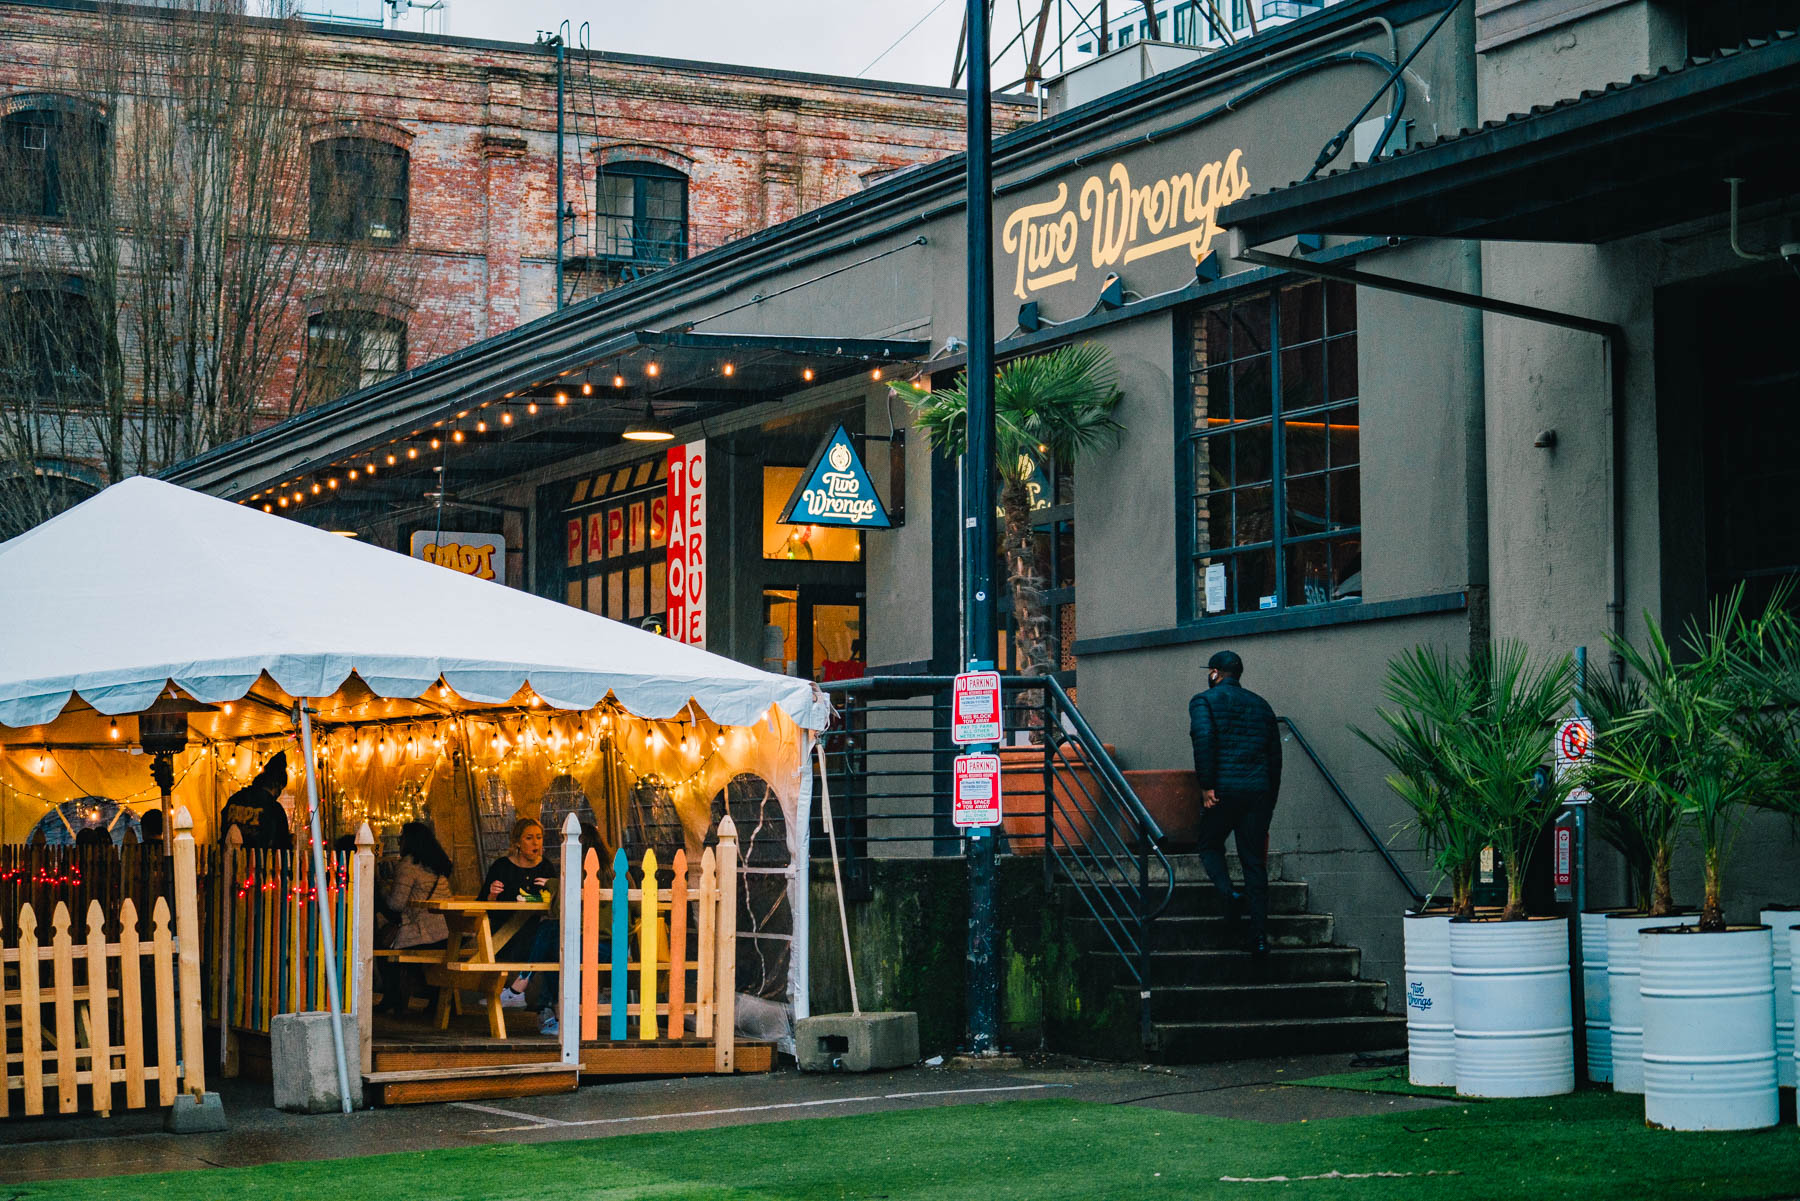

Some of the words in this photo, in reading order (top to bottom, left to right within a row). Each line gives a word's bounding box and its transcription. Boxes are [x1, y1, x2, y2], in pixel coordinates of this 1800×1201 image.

[1002, 182, 1078, 300] Two
[1079, 148, 1252, 269] Wrongs
[822, 470, 860, 498] Two
[802, 489, 877, 523] Wrongs
[568, 498, 665, 561] PAPI'S
[957, 678, 967, 692] NO
[969, 678, 994, 688] PARKING
[957, 760, 967, 774] NO
[969, 761, 994, 771] PARKING
[1411, 982, 1424, 996] Two
